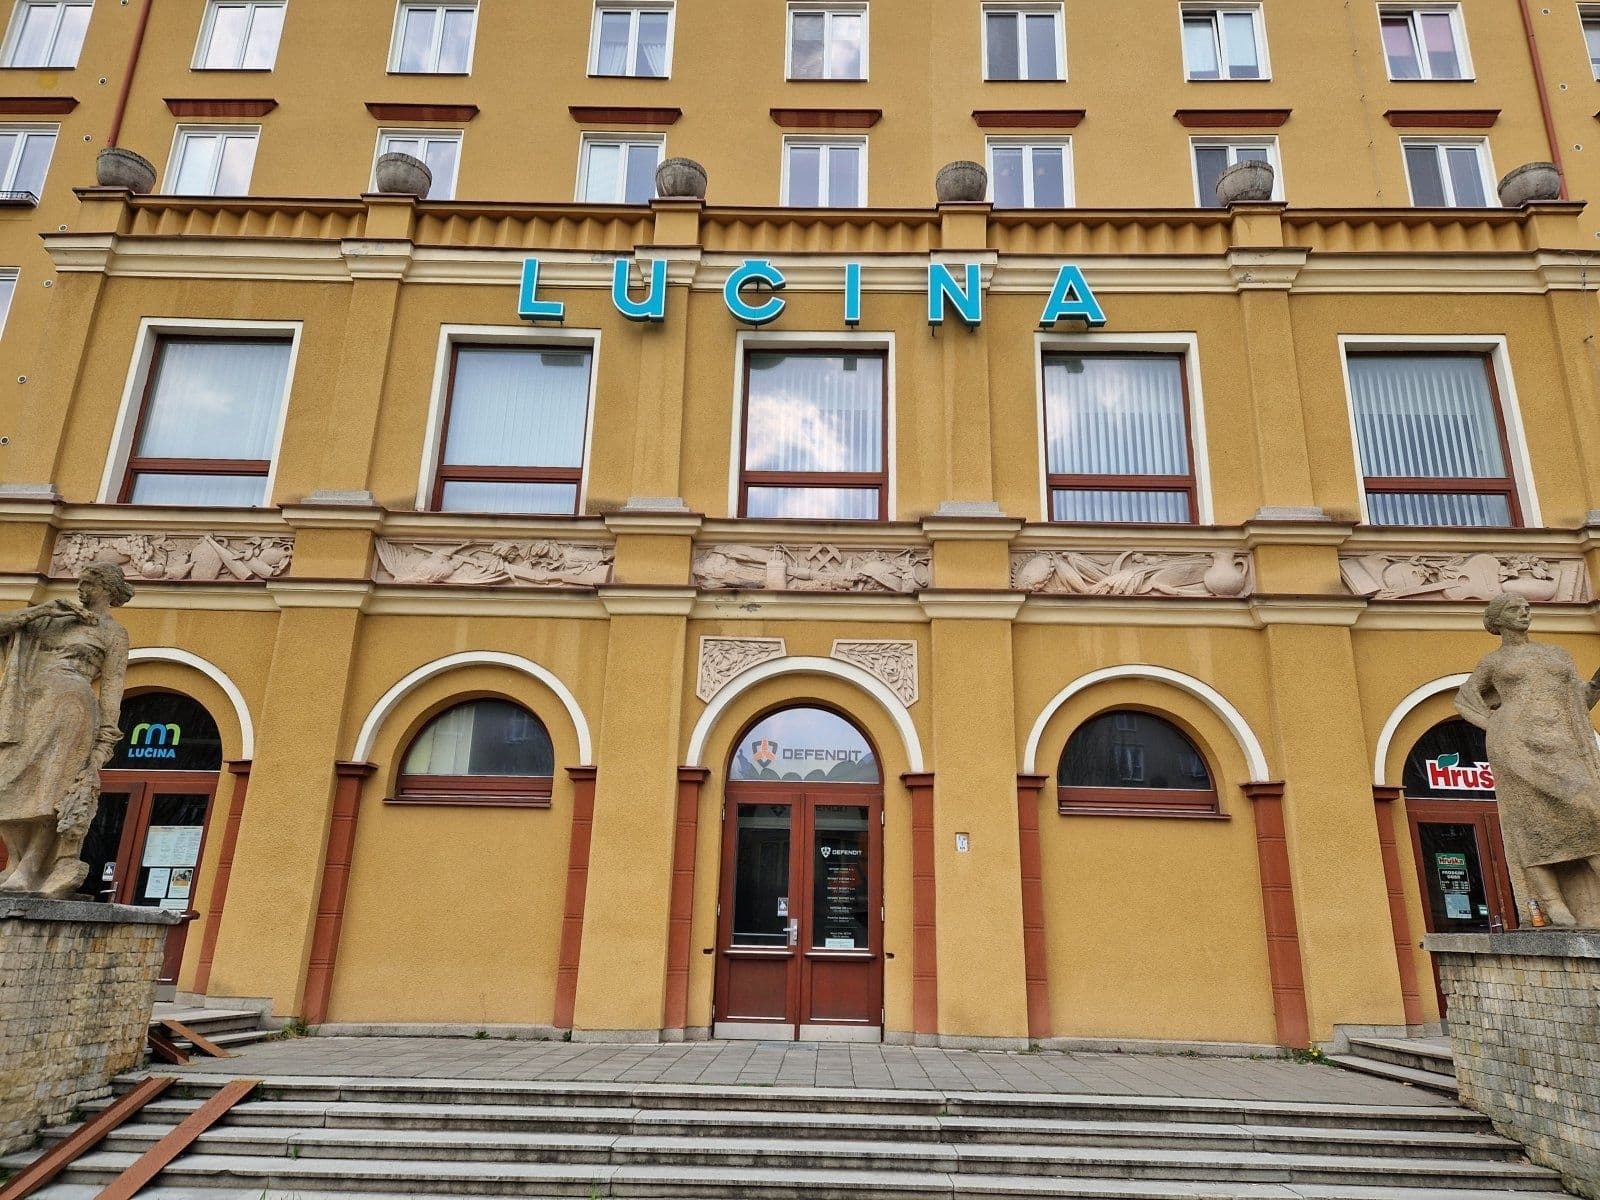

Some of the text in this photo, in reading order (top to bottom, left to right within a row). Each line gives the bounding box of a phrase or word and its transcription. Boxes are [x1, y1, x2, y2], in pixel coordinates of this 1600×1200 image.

[517, 257, 1108, 327] LUČINA
[782, 748, 862, 761] DEFENDIT
[1429, 762, 1495, 789] Hruš
